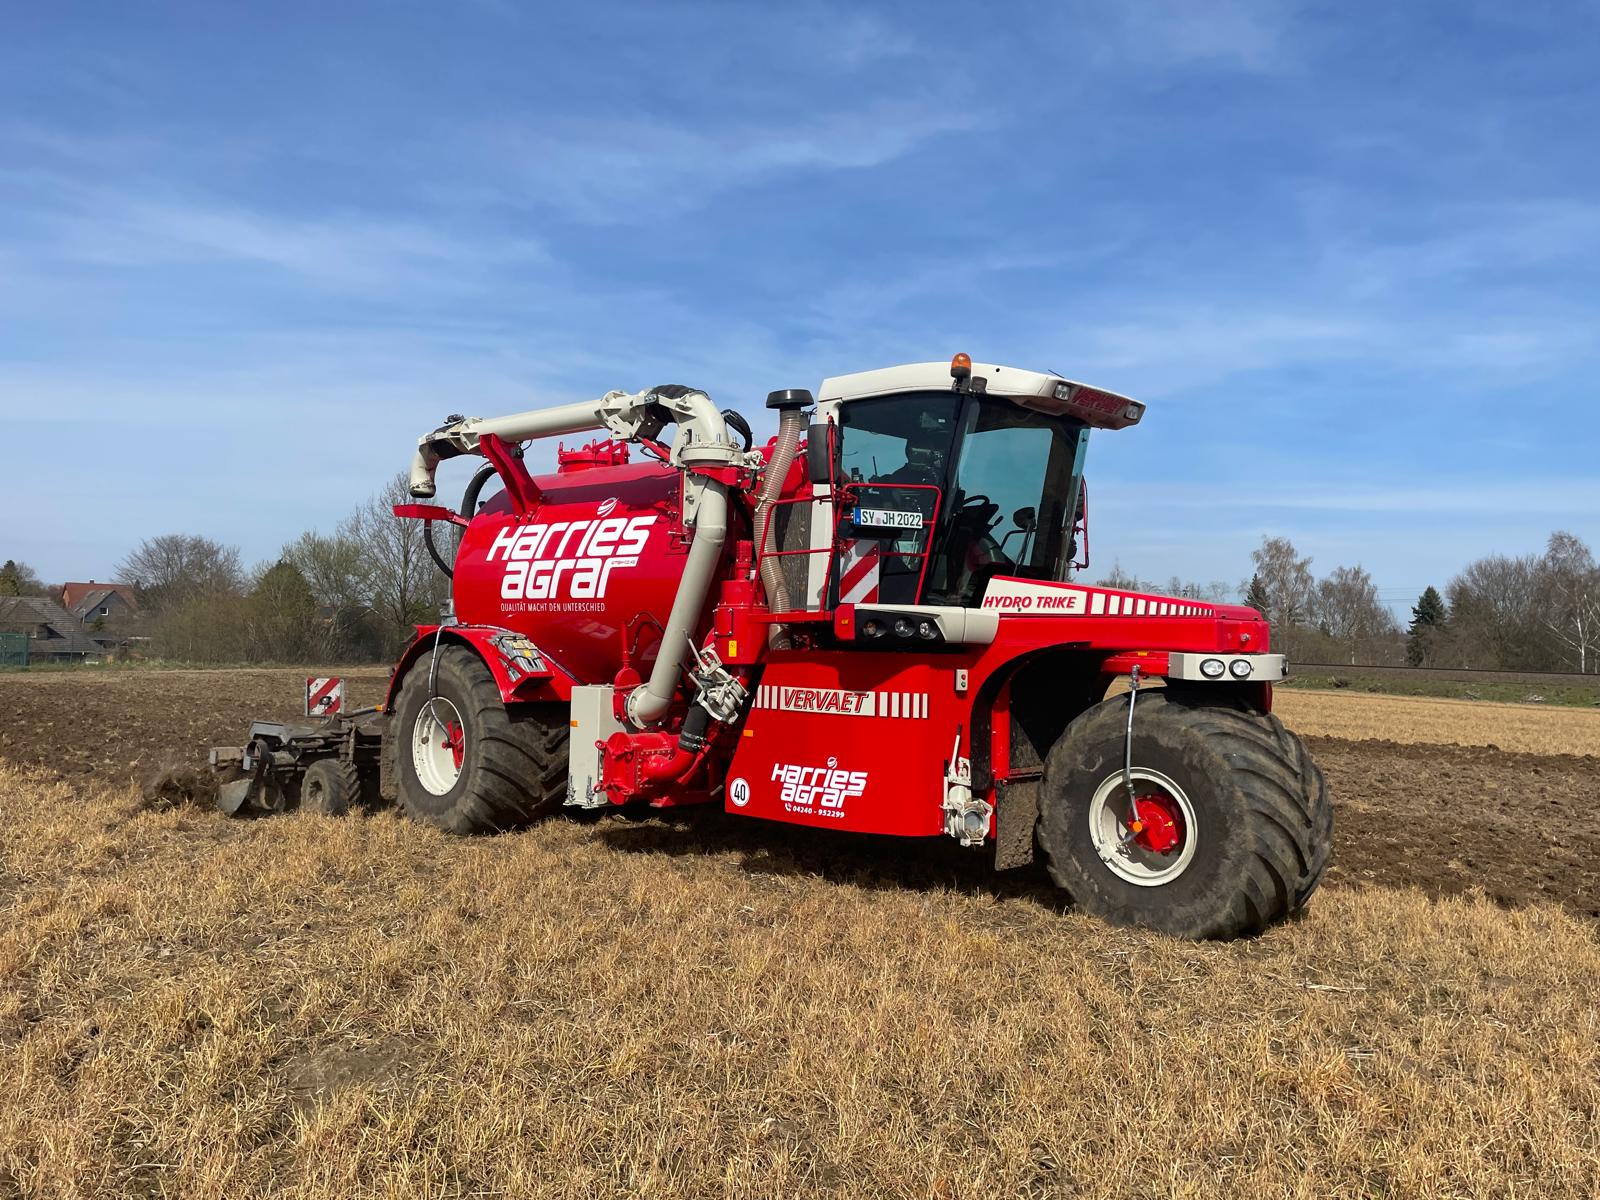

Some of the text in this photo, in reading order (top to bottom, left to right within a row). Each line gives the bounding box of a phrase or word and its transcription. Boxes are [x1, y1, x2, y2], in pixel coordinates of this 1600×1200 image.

[862, 510, 921, 527] SY JH 2022
[500, 601, 605, 612] QUALITÄT MACHT DEN UNTERSCHIED
[983, 595, 1077, 609] HYDRO TRIKE
[783, 688, 869, 713] VERVAET
[733, 783, 746, 801] 40
[792, 805, 813, 814] 04240
[818, 808, 845, 819] 952299
